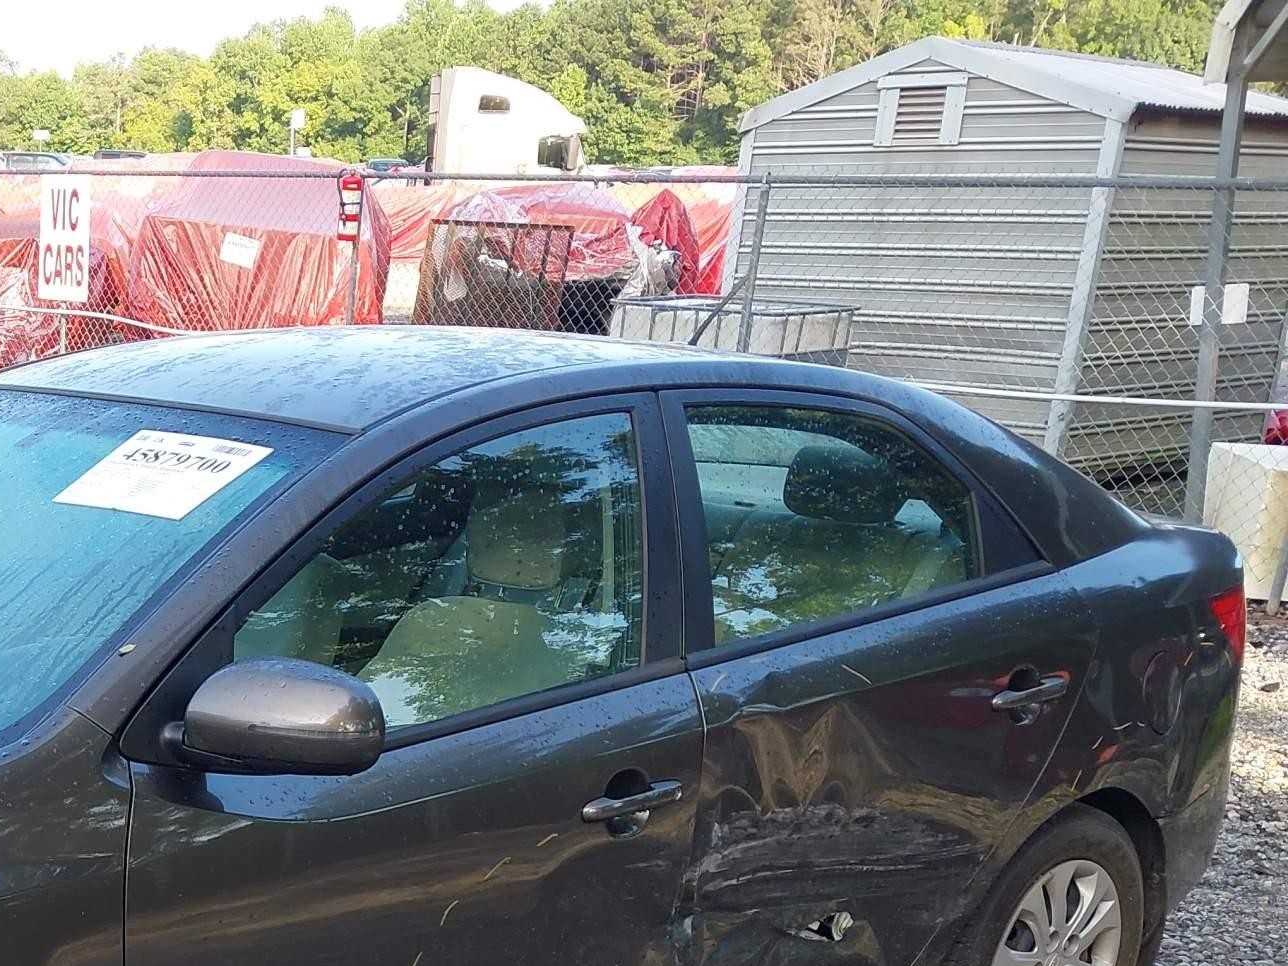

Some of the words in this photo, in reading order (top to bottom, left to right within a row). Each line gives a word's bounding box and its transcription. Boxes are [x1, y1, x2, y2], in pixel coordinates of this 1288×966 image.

[51, 188, 79, 231] VIC
[43, 243, 84, 287] CARS
[122, 447, 232, 474] 45879700
